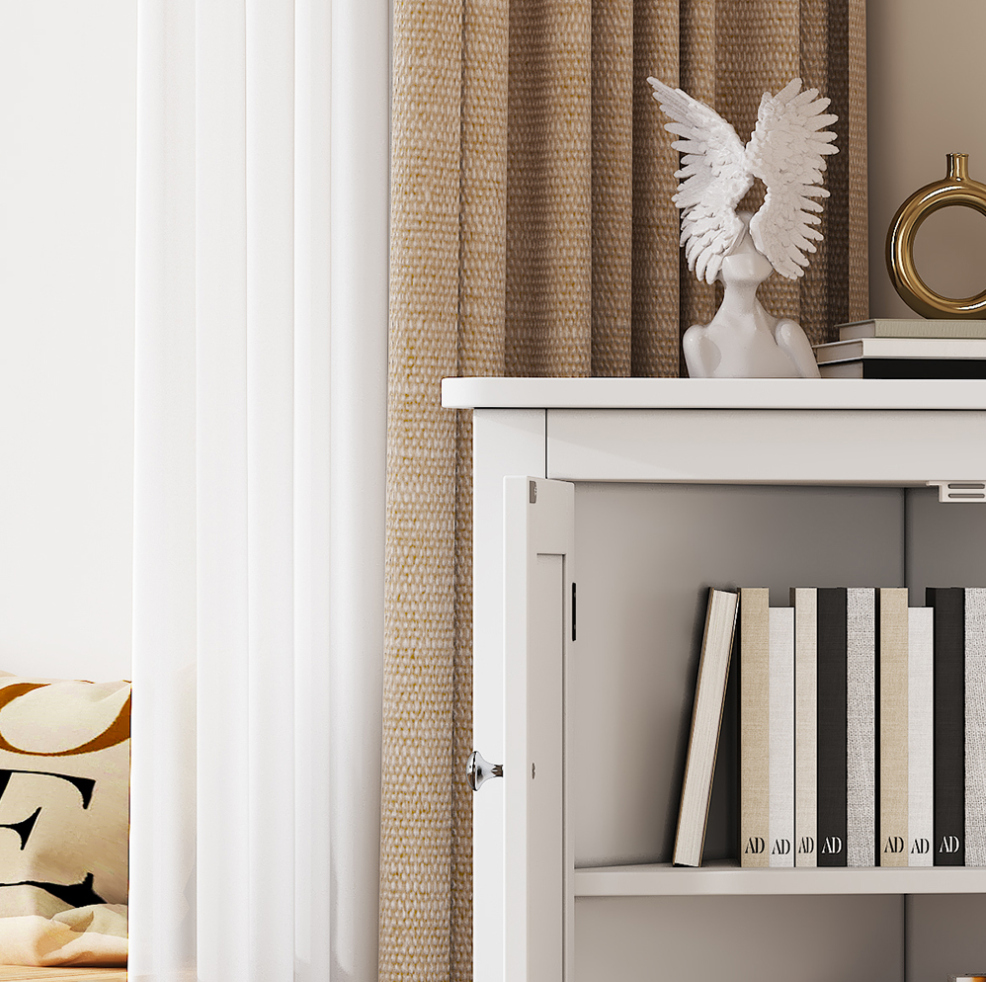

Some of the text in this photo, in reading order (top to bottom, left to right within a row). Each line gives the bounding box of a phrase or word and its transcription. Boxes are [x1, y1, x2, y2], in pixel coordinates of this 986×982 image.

[744, 836, 765, 854] AD
[771, 838, 791, 855] AD
[798, 836, 814, 854] AD
[821, 836, 842, 854] AD
[884, 836, 905, 854] AD
[911, 838, 930, 855] AD
[939, 835, 960, 853] AD
